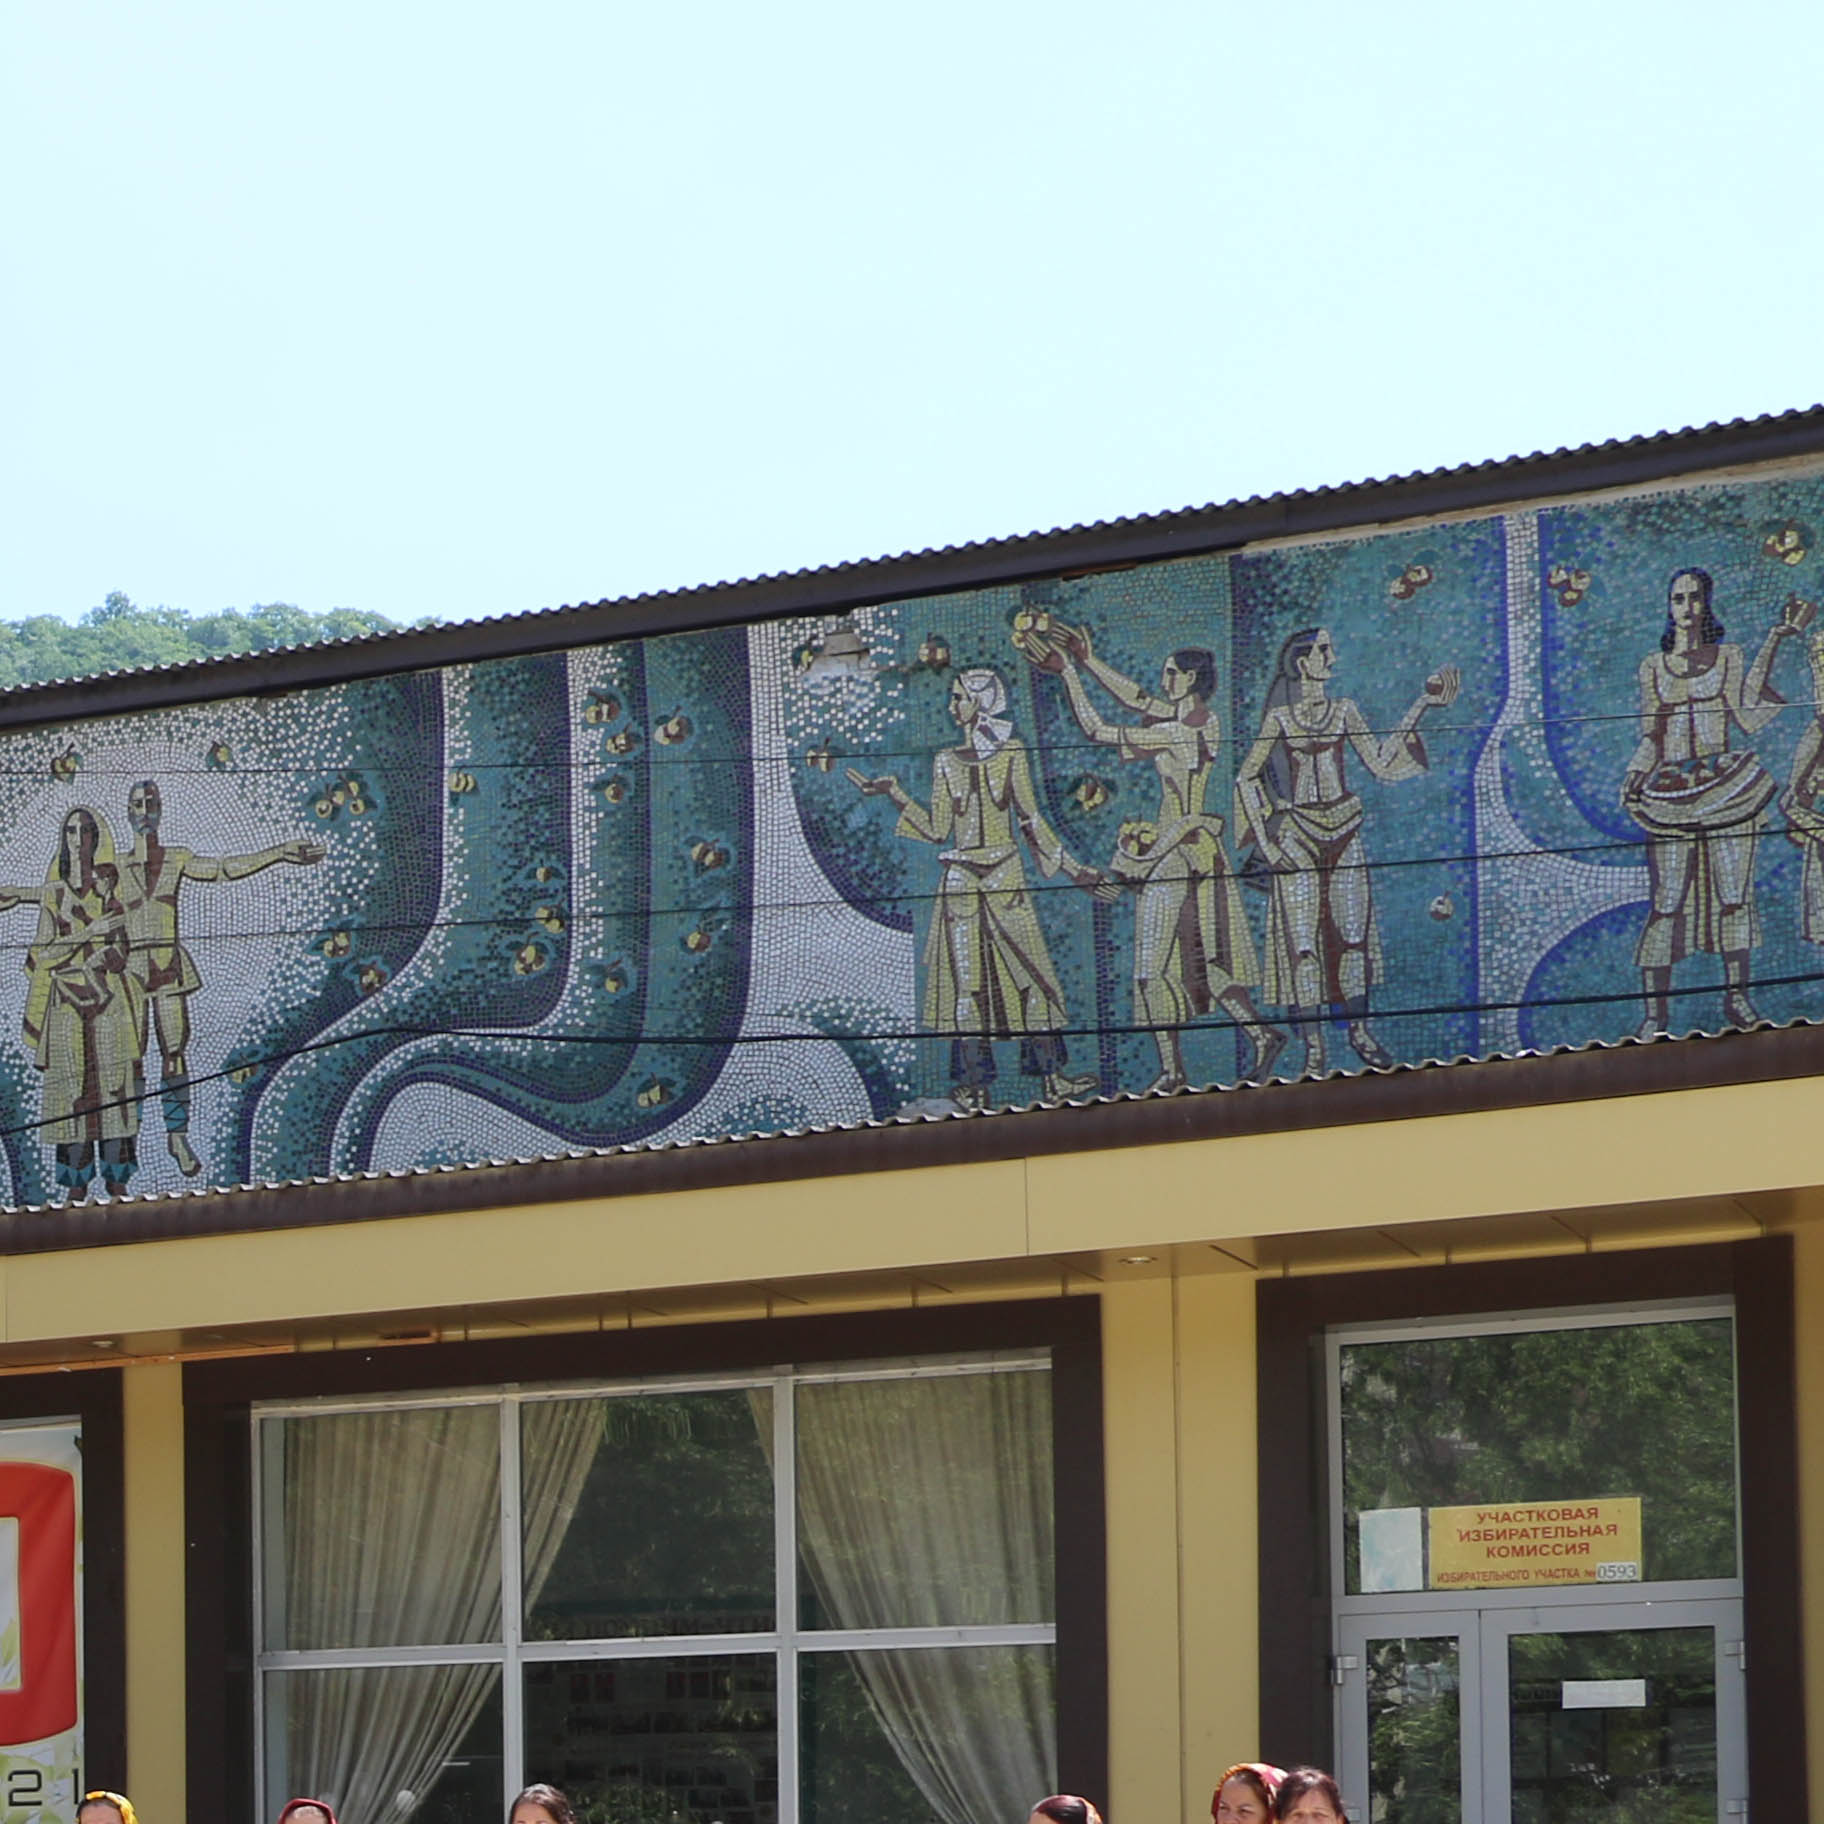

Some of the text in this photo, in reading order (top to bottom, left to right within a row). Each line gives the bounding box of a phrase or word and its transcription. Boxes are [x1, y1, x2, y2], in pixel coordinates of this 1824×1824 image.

[1477, 1506, 1600, 1524] УЧАСТКОВАЯ
[1459, 1524, 1619, 1543] ИЗБИРАТЕЛЬНАЯ
[1486, 1542, 1591, 1559] КОМИССИЯ
[1437, 1569, 1530, 1584] ИЗБИРАТЕЛЬНОГО
[1534, 1568, 1580, 1580] УЧАСТКА
